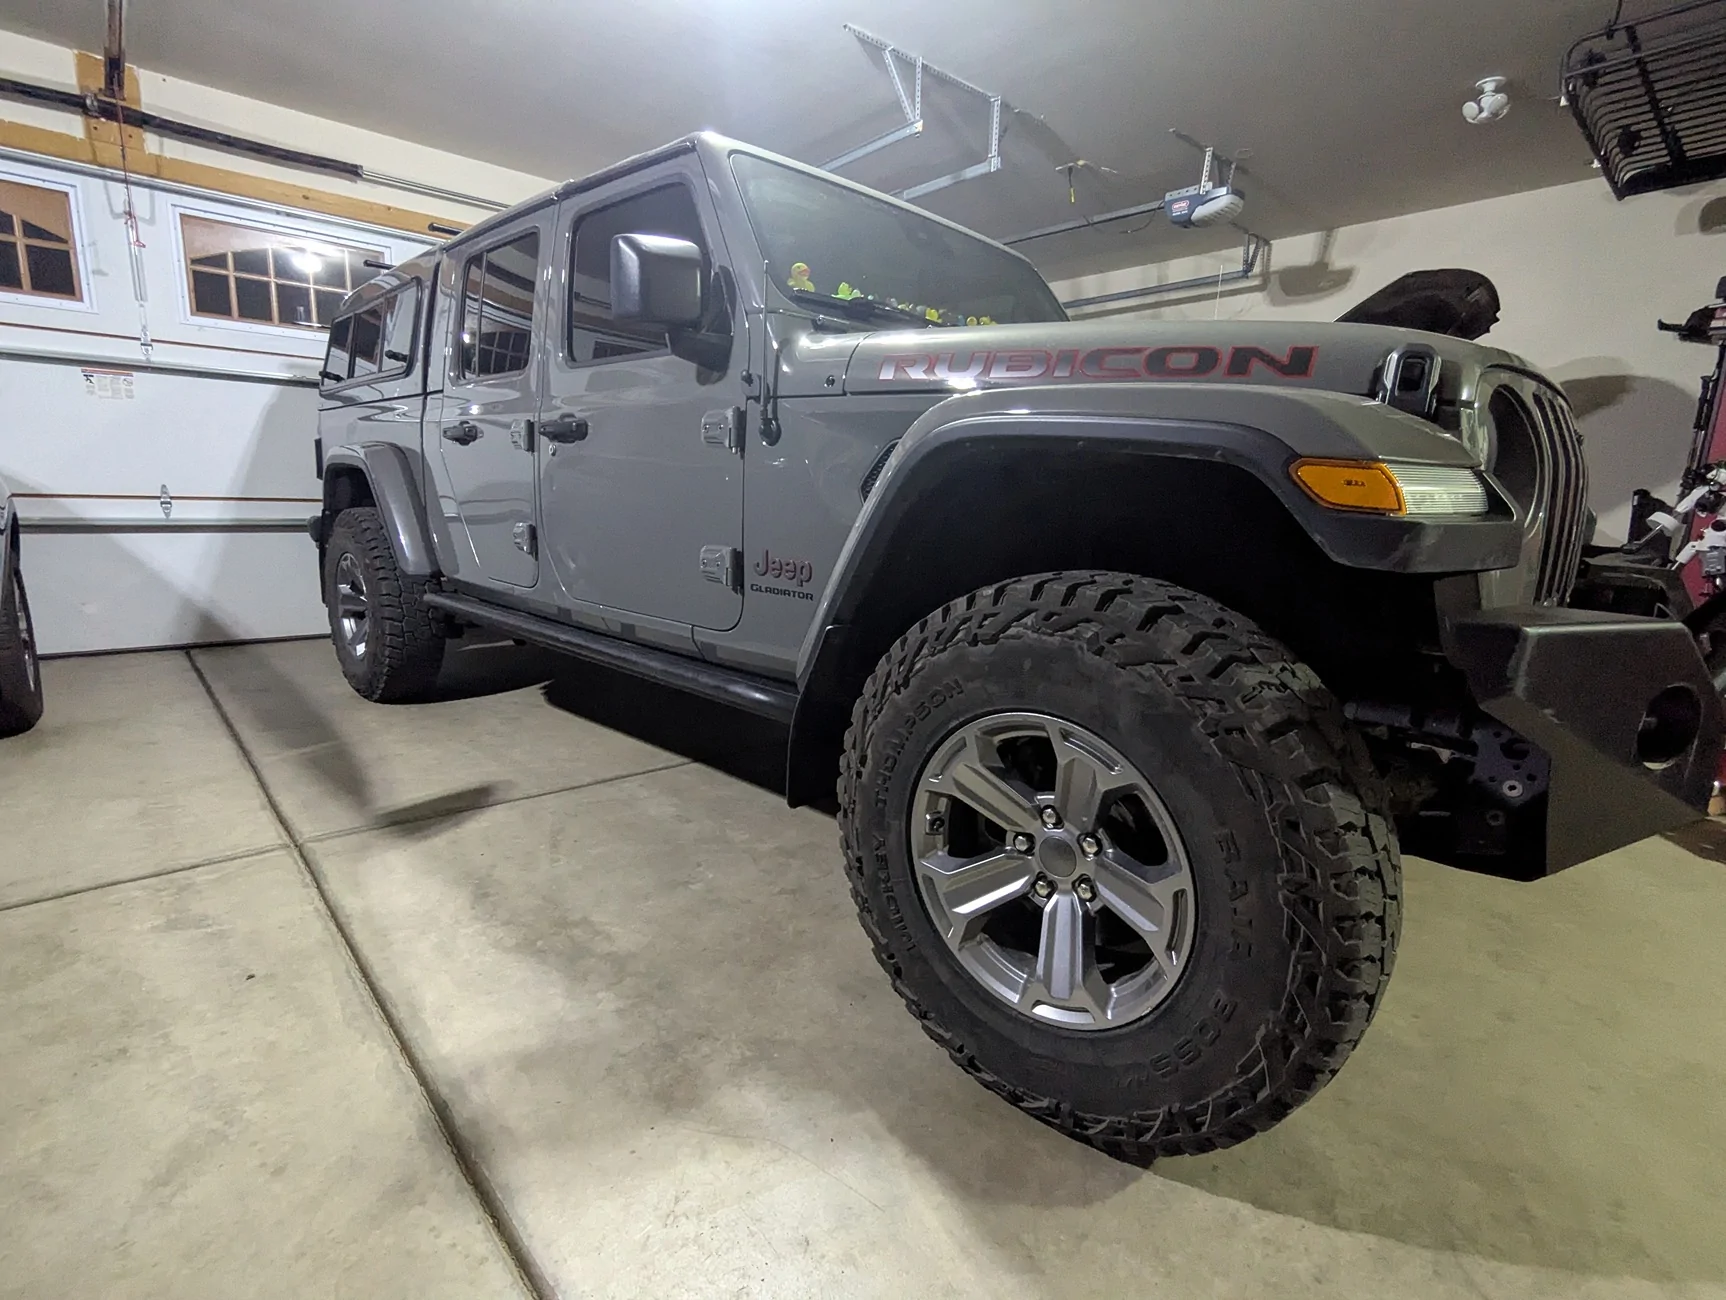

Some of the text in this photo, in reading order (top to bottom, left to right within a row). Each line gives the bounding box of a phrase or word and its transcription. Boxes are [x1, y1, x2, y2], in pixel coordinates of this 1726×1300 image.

[877, 345, 1319, 381] RUBICON
[753, 549, 813, 587] Jeep
[750, 583, 814, 601] GLADIATOR
[875, 678, 965, 808] THOMPSON
[1150, 989, 1239, 1080] BOSS
